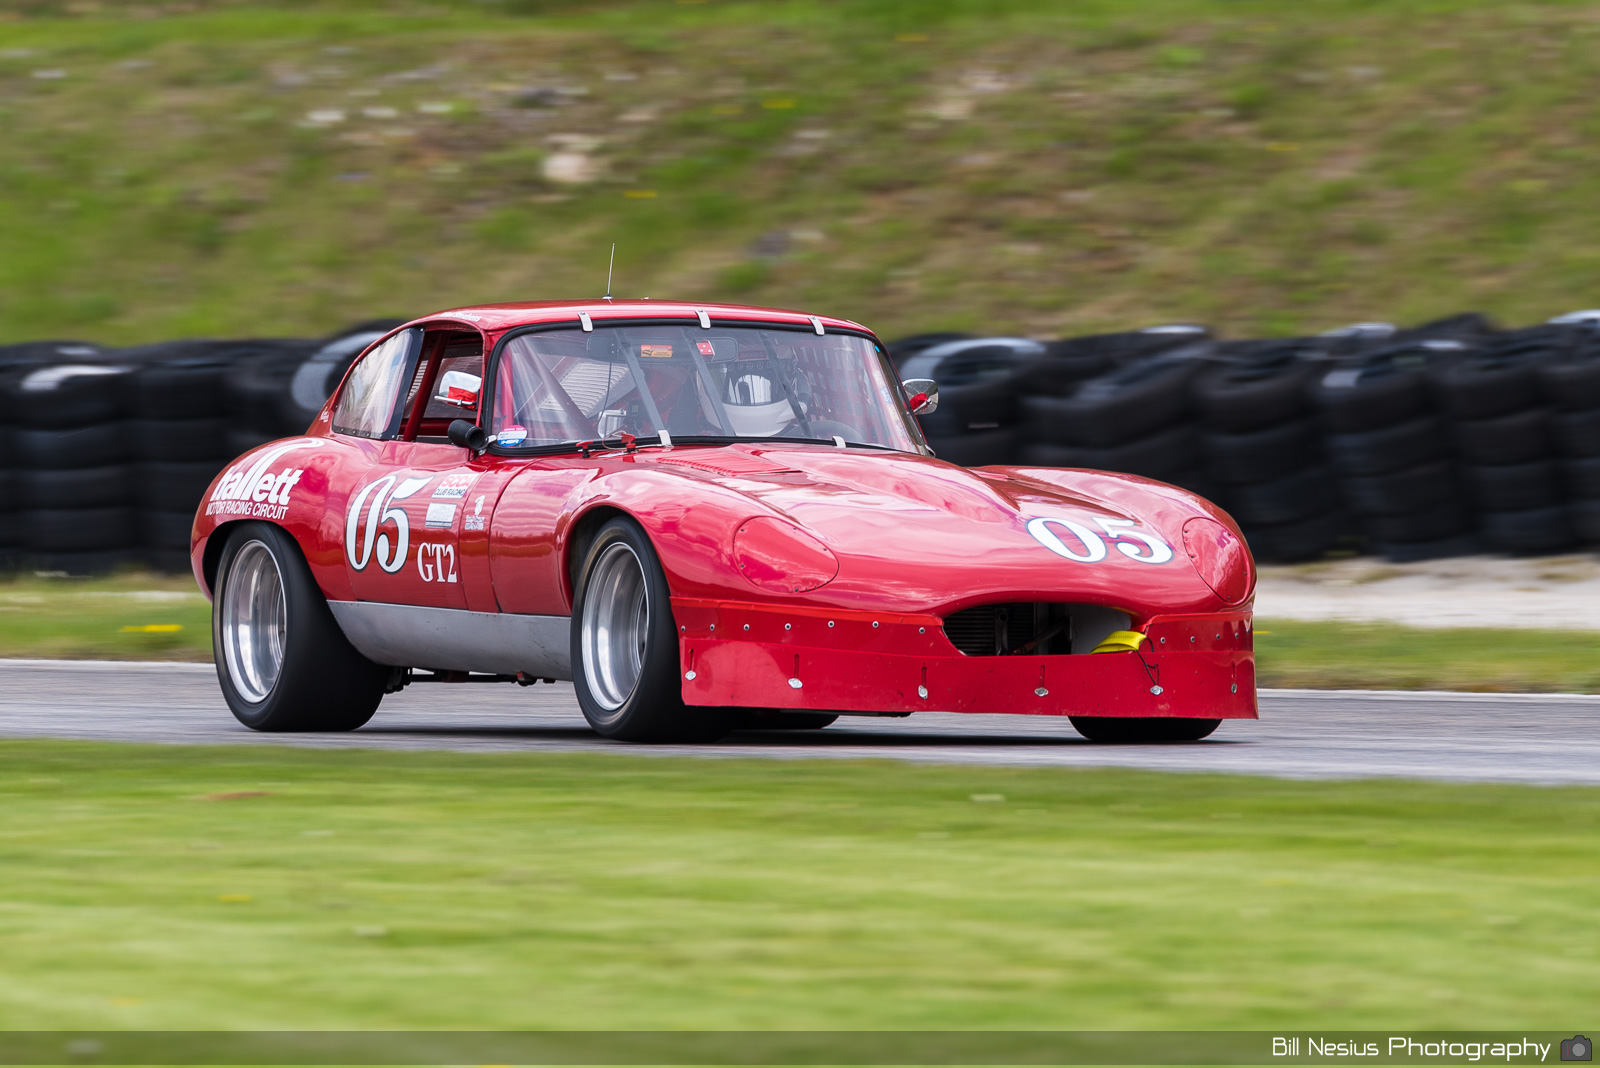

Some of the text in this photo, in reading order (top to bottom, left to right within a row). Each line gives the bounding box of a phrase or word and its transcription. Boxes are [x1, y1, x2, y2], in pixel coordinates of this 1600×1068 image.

[210, 445, 308, 506] hallett
[433, 488, 466, 497] CLUB RACING
[440, 475, 473, 488] SCCA
[205, 501, 289, 520] MOTOR RACING CIRCUIT
[346, 474, 436, 575] 05
[1024, 516, 1175, 565] 05
[417, 542, 458, 583] GT2
